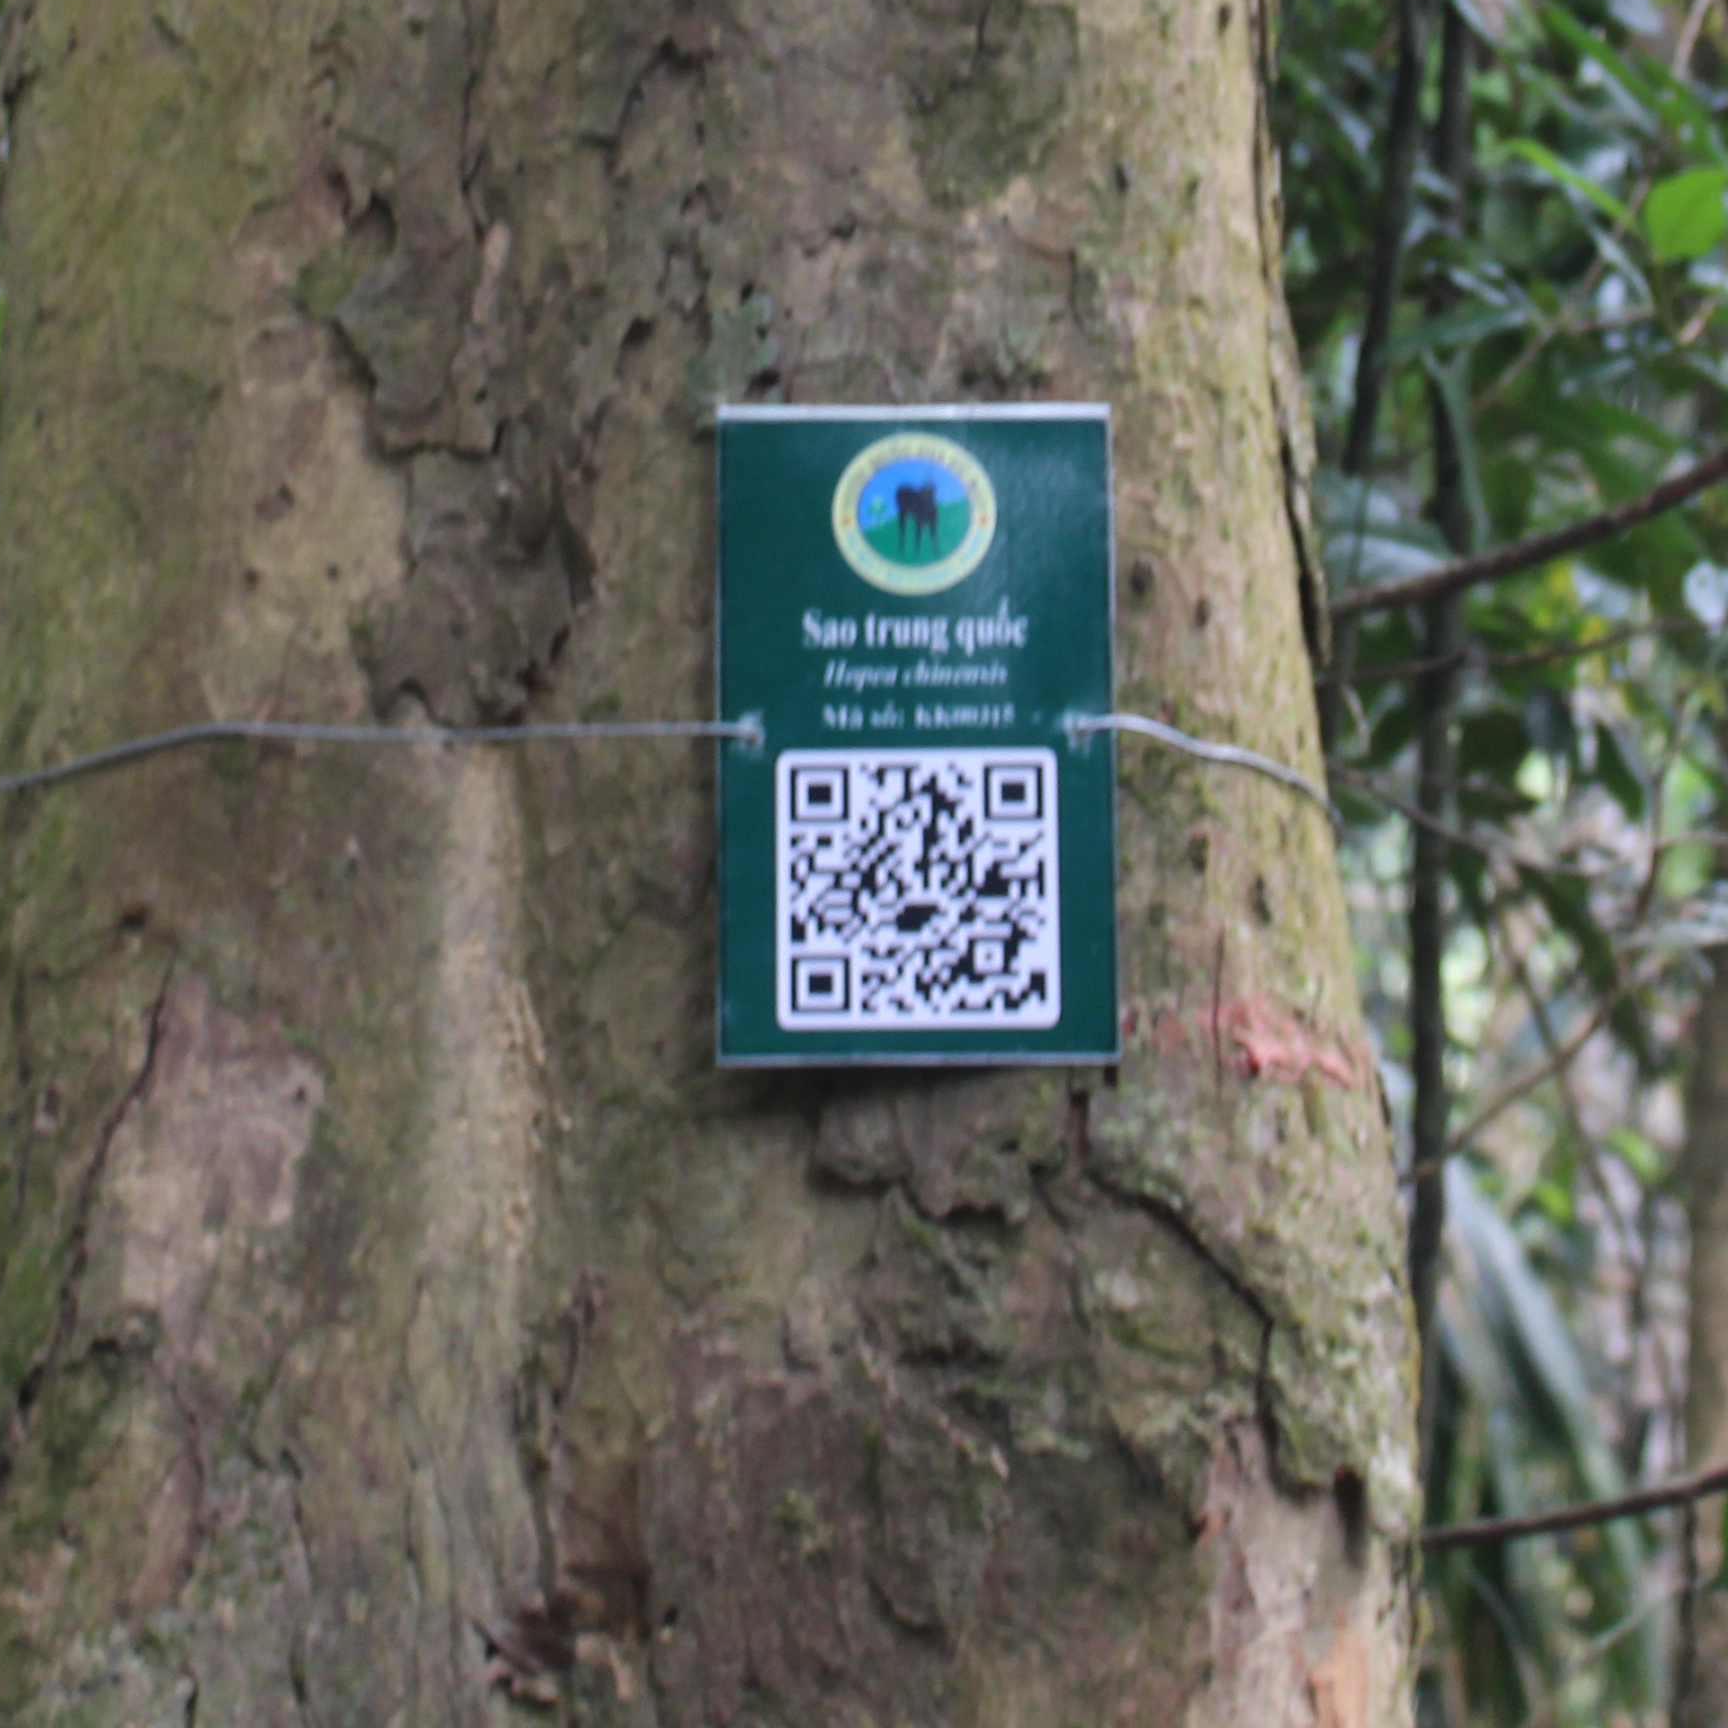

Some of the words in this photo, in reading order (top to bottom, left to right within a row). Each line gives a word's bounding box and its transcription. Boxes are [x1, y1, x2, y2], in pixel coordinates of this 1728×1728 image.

[802, 607, 858, 648] Sao
[864, 611, 949, 657] trung
[955, 594, 1029, 657] quốc
[825, 659, 898, 693] Hopea
